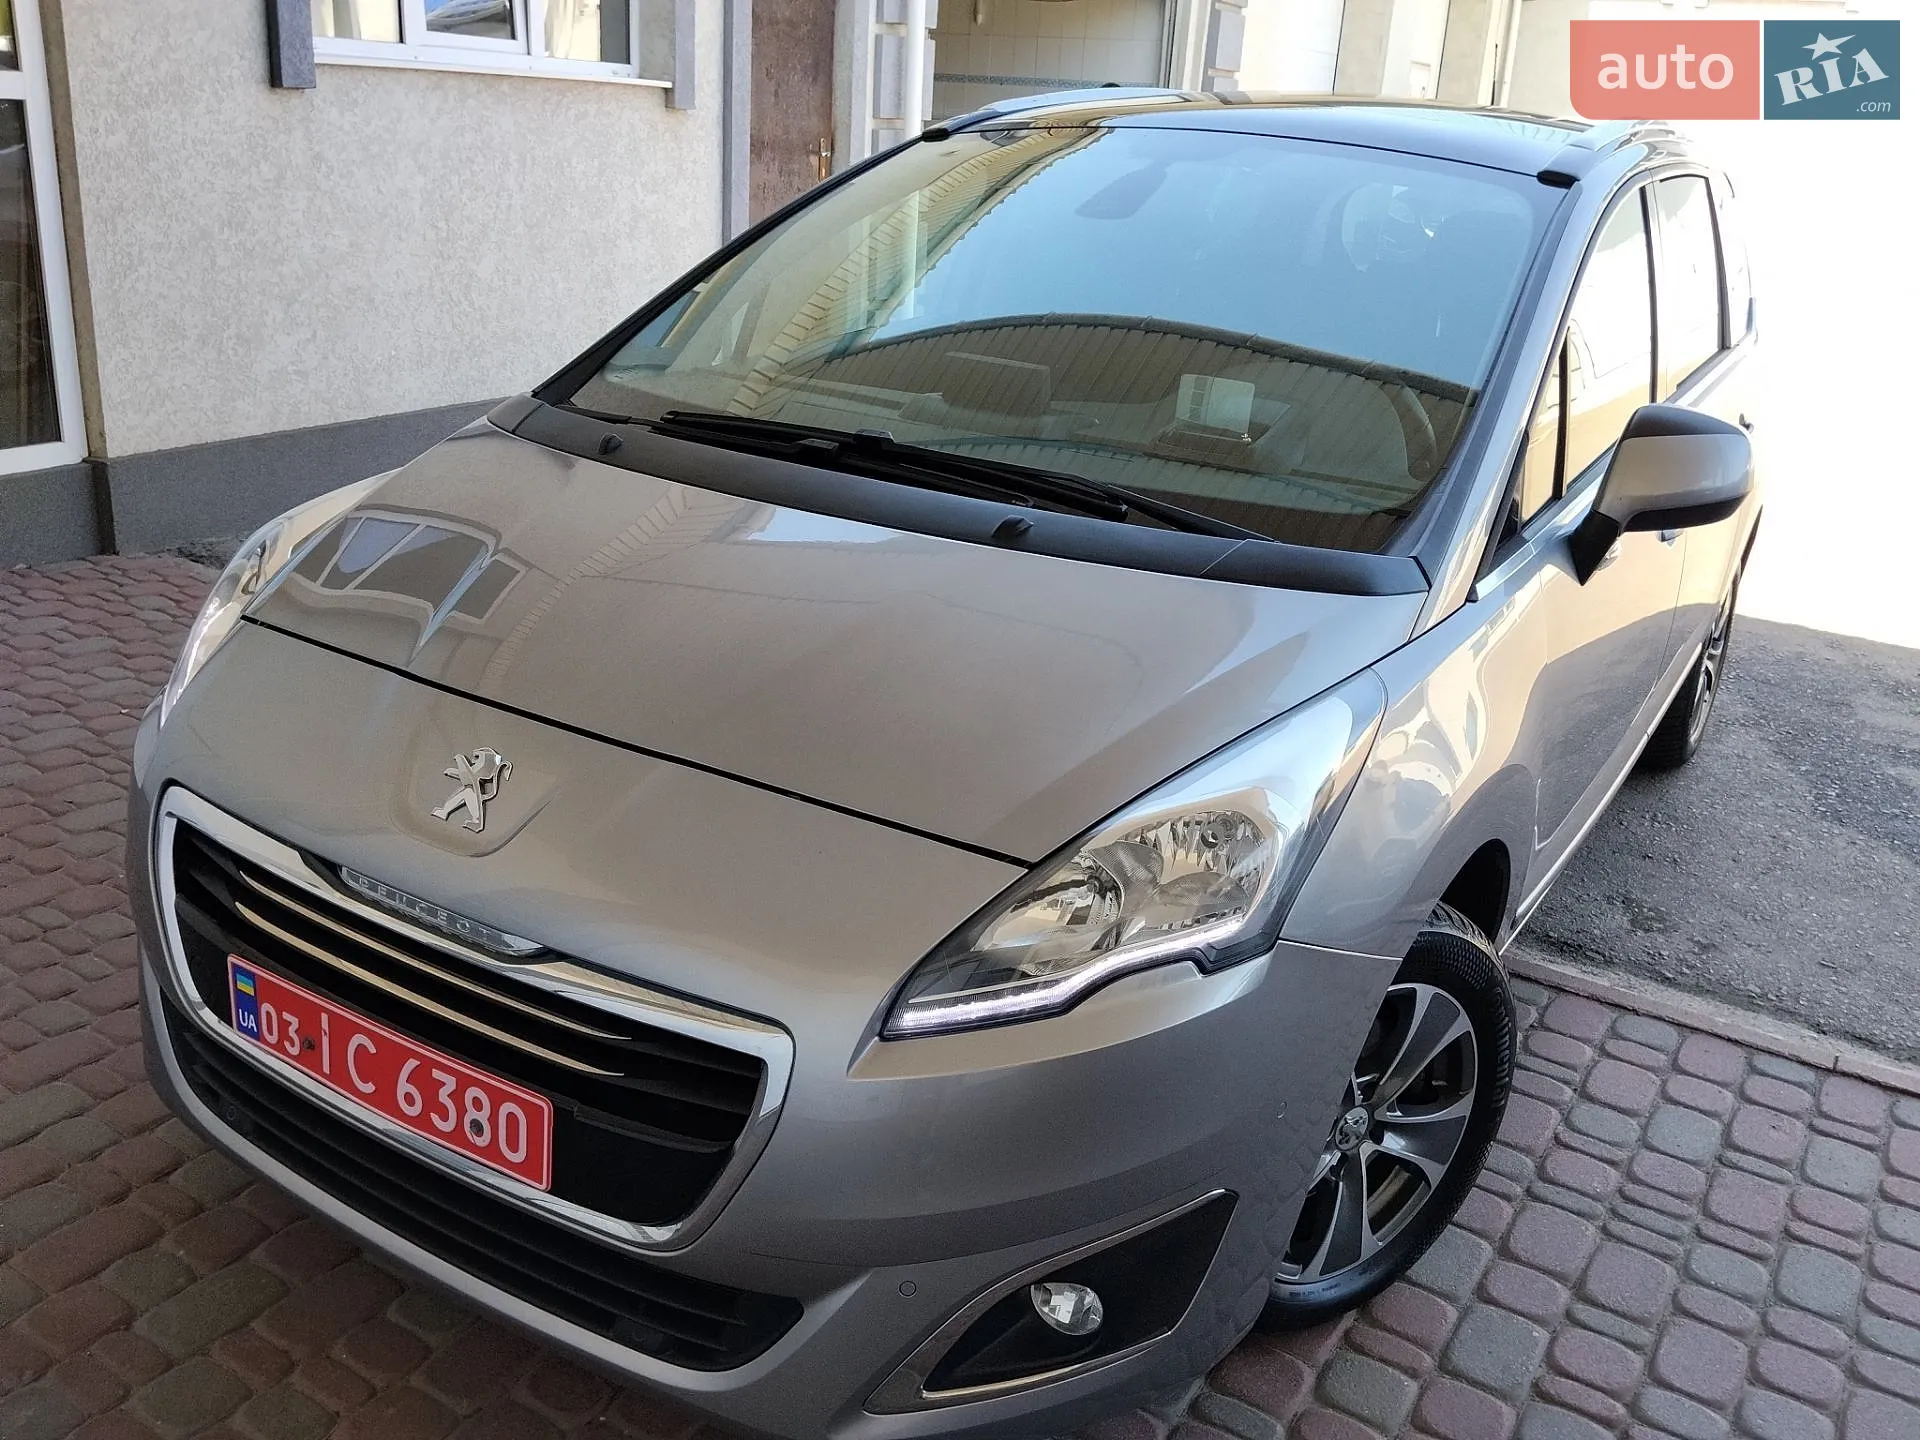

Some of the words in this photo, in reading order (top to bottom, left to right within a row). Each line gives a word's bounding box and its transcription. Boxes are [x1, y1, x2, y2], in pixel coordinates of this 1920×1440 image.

[239, 1012, 257, 1033] UA
[261, 1002, 300, 1055] 03
[397, 1058, 528, 1164] 6380
